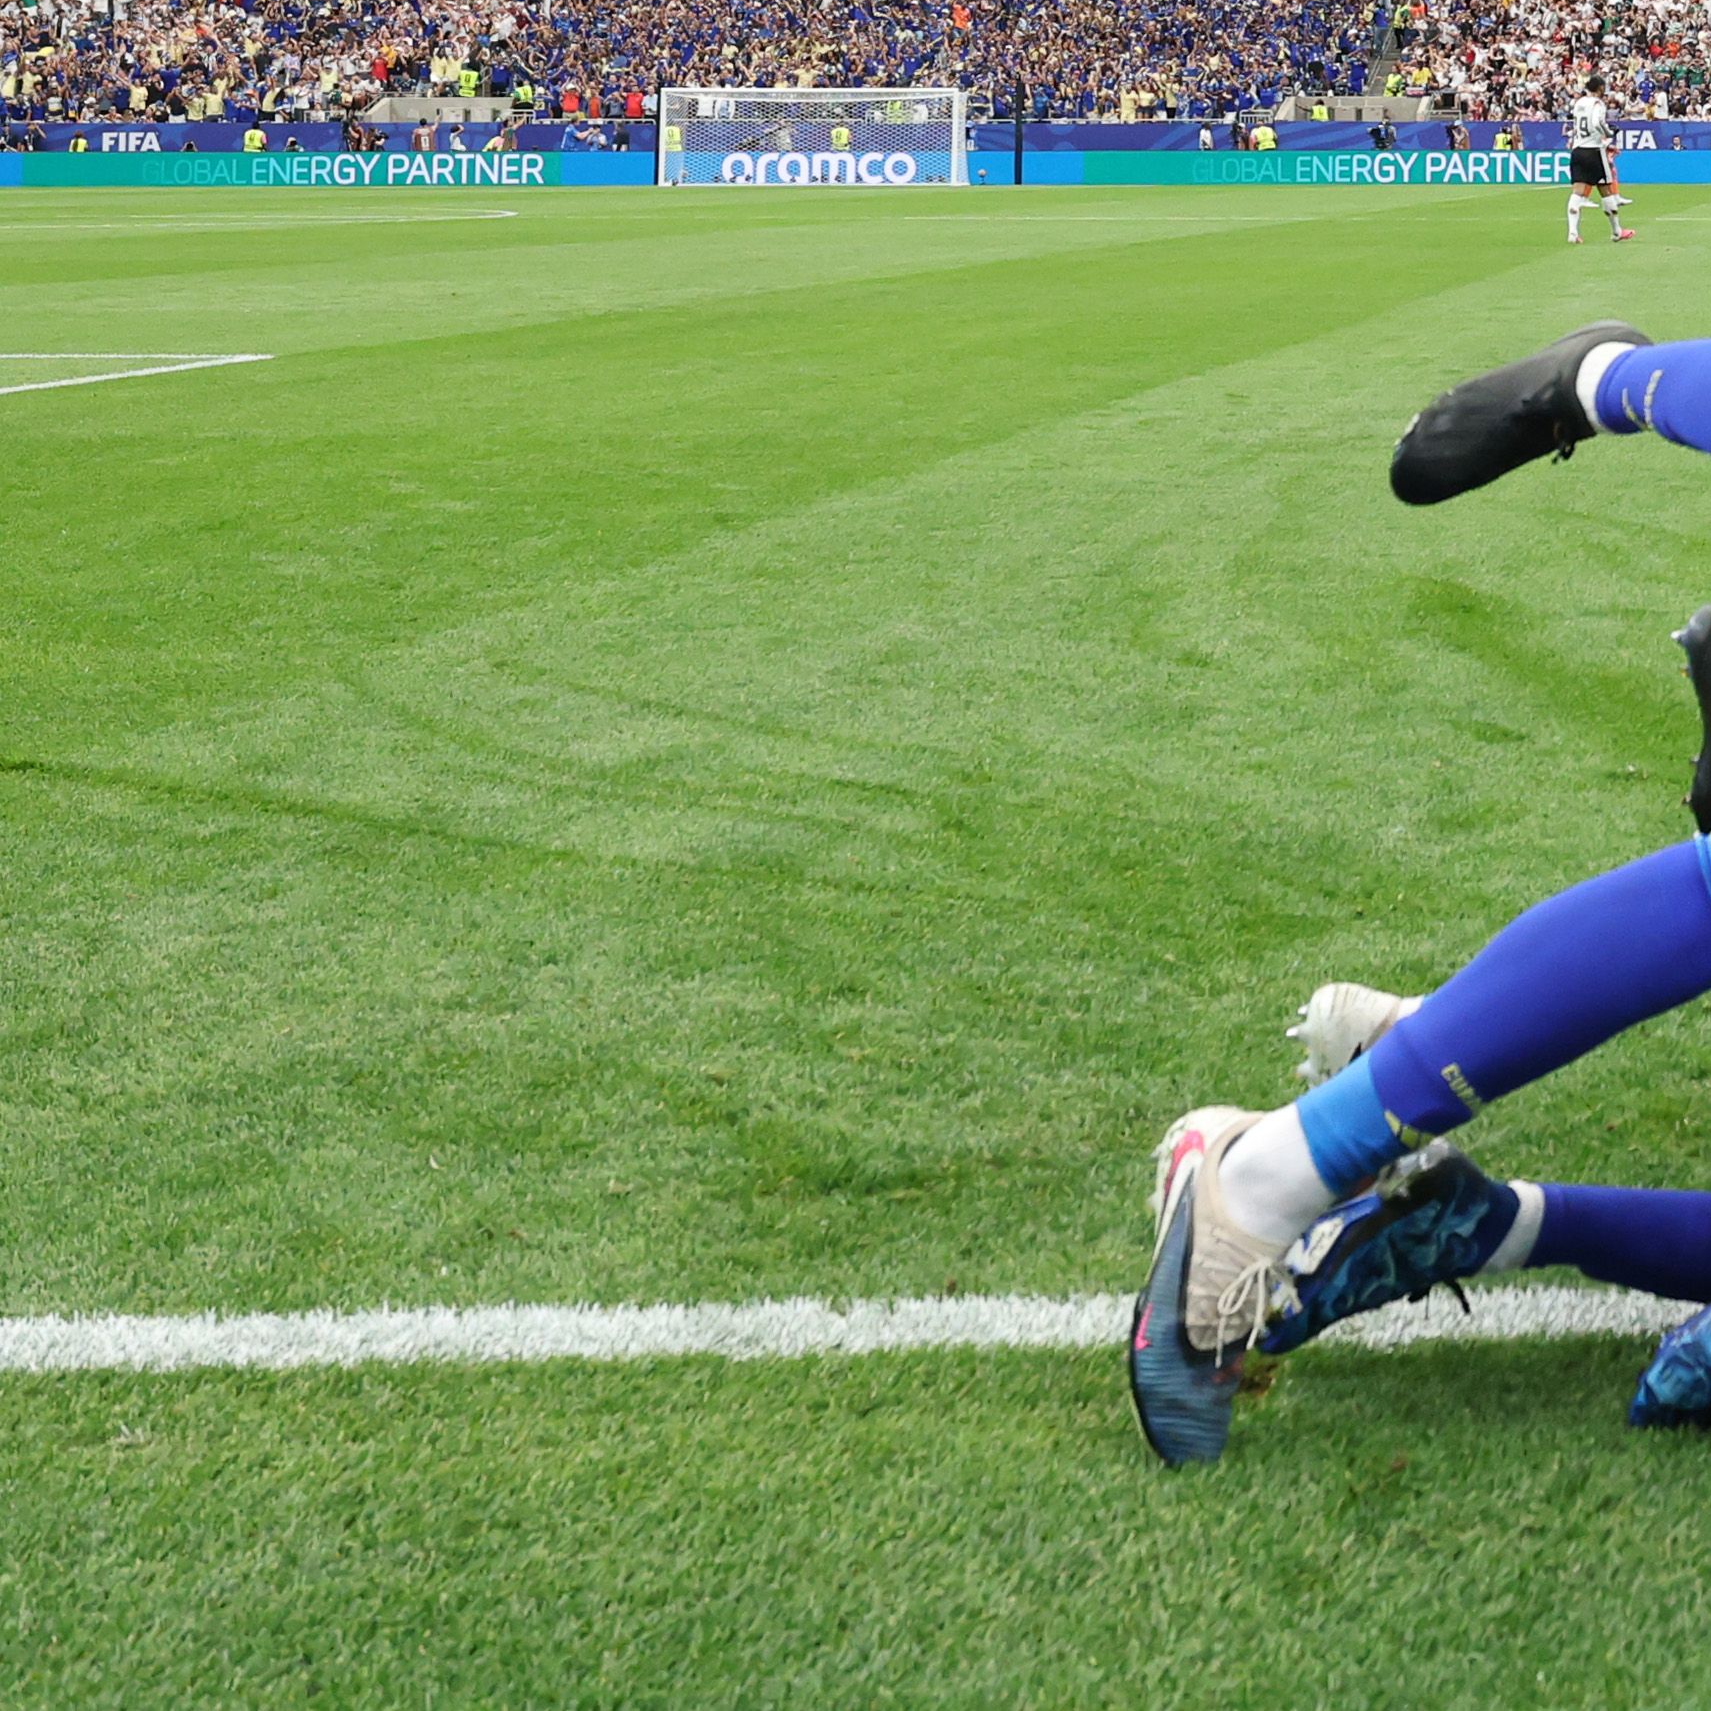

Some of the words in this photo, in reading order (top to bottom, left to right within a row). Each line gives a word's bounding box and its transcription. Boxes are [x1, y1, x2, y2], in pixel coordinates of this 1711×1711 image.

[102, 132, 162, 152] FIFA
[1616, 130, 1657, 149] IFA
[252, 154, 378, 186] ENERGY
[387, 153, 545, 186] PARTNER
[722, 151, 917, 184] aramco
[1296, 153, 1418, 184] ENERGY
[1426, 152, 1572, 185] PARTNER
